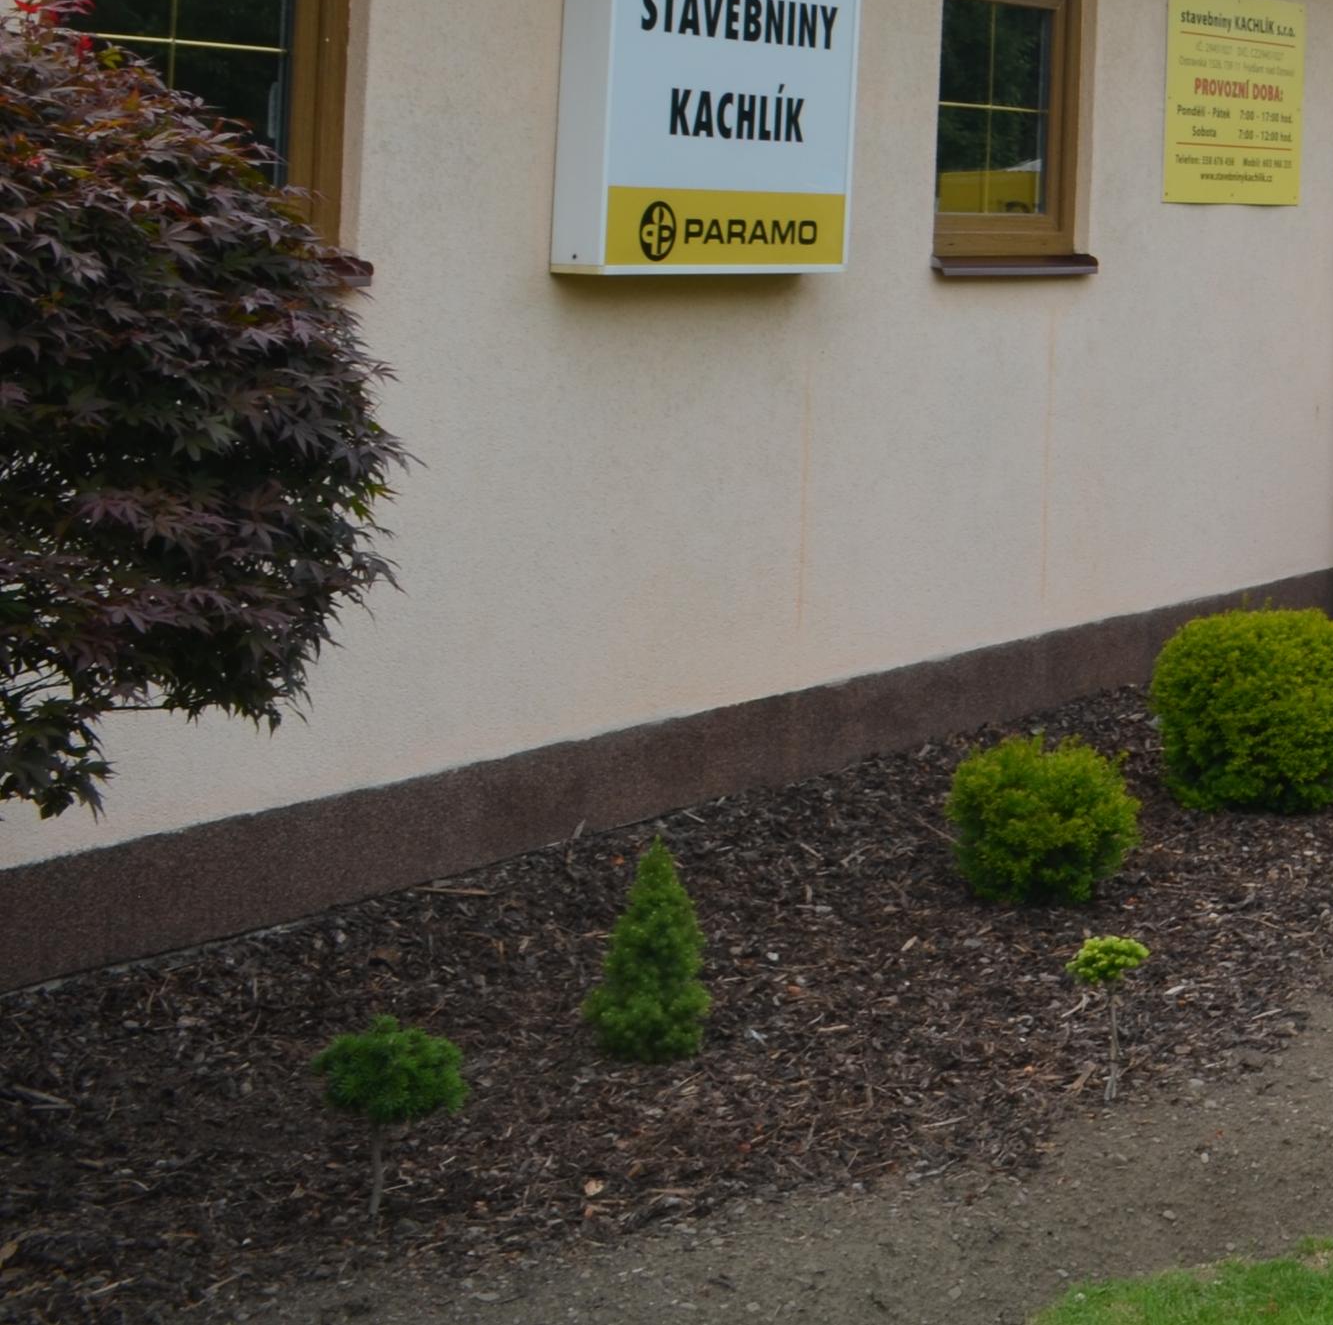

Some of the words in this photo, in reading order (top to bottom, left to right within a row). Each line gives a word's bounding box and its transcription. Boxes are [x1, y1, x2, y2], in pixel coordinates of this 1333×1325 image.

[1180, 9, 1232, 34] stavebniny
[1234, 15, 1275, 36] KACHLÍK
[1277, 24, 1296, 38] s.r.o.
[1194, 77, 1250, 100] PROVOZNÍ
[1252, 83, 1284, 102] DOBA:
[669, 84, 805, 143] KACHLÍK
[1192, 125, 1217, 139] Sobota
[684, 219, 818, 245] PARAMO
